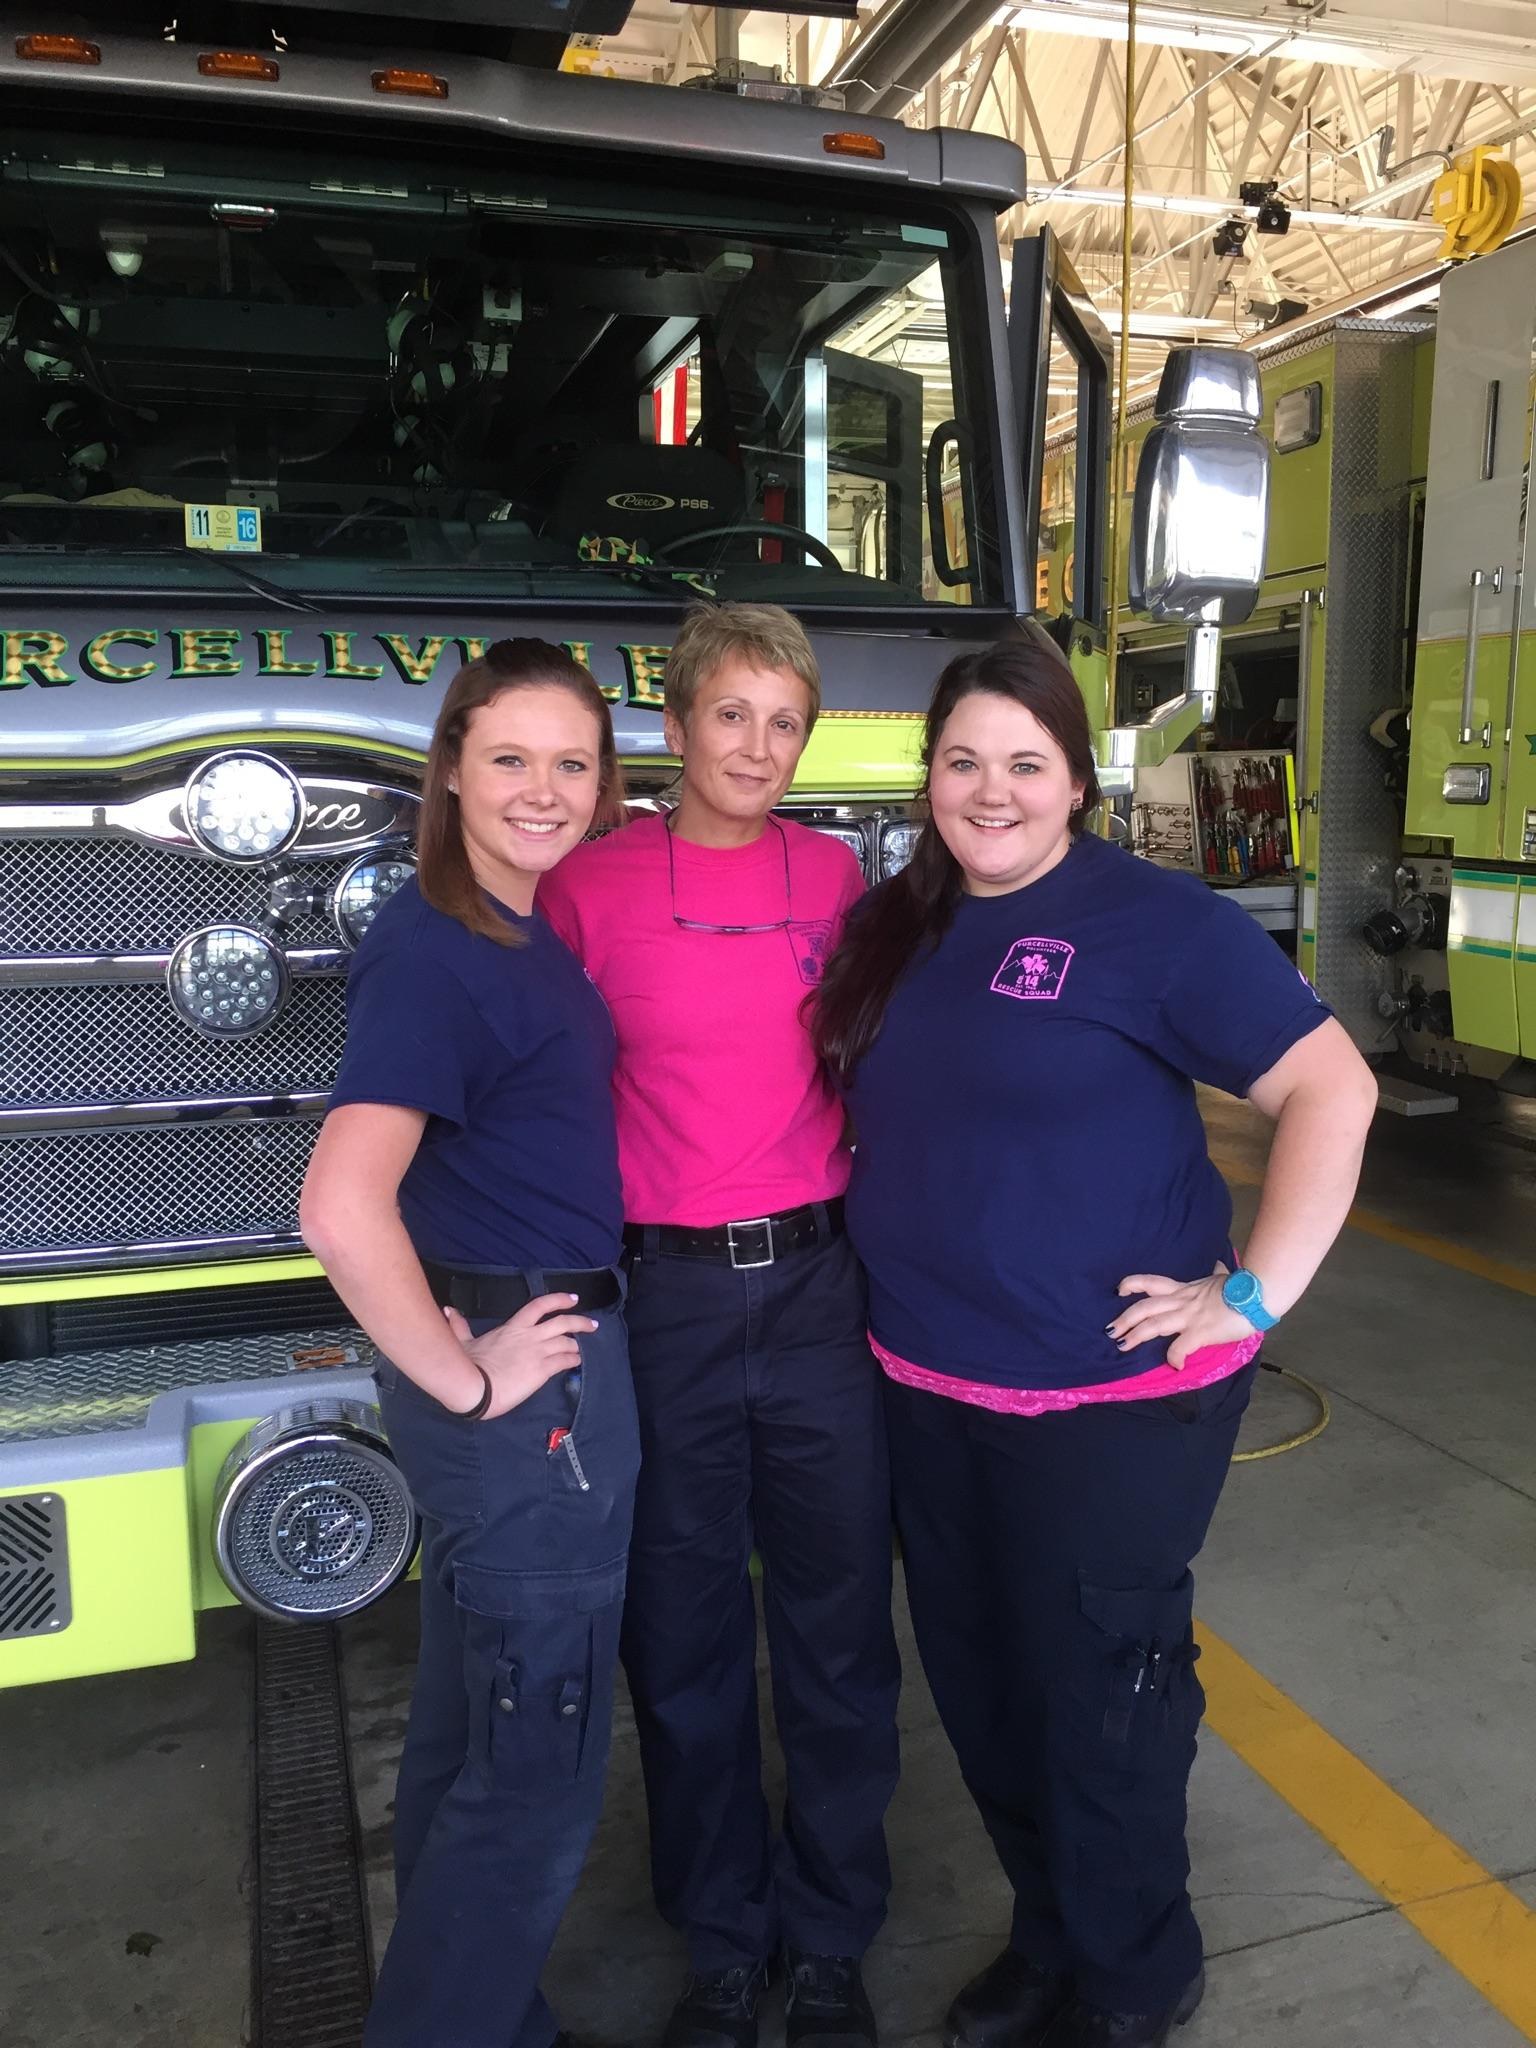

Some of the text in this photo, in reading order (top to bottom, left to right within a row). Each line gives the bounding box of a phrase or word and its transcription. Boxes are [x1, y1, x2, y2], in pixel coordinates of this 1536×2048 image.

[622, 495, 661, 507] Pierce
[196, 509, 209, 536] 11
[239, 517, 257, 539] 16
[0, 629, 673, 705] RCELLVLE
[1017, 941, 1069, 953] PURCELLVILLE
[997, 983, 1022, 995] RESCUE
